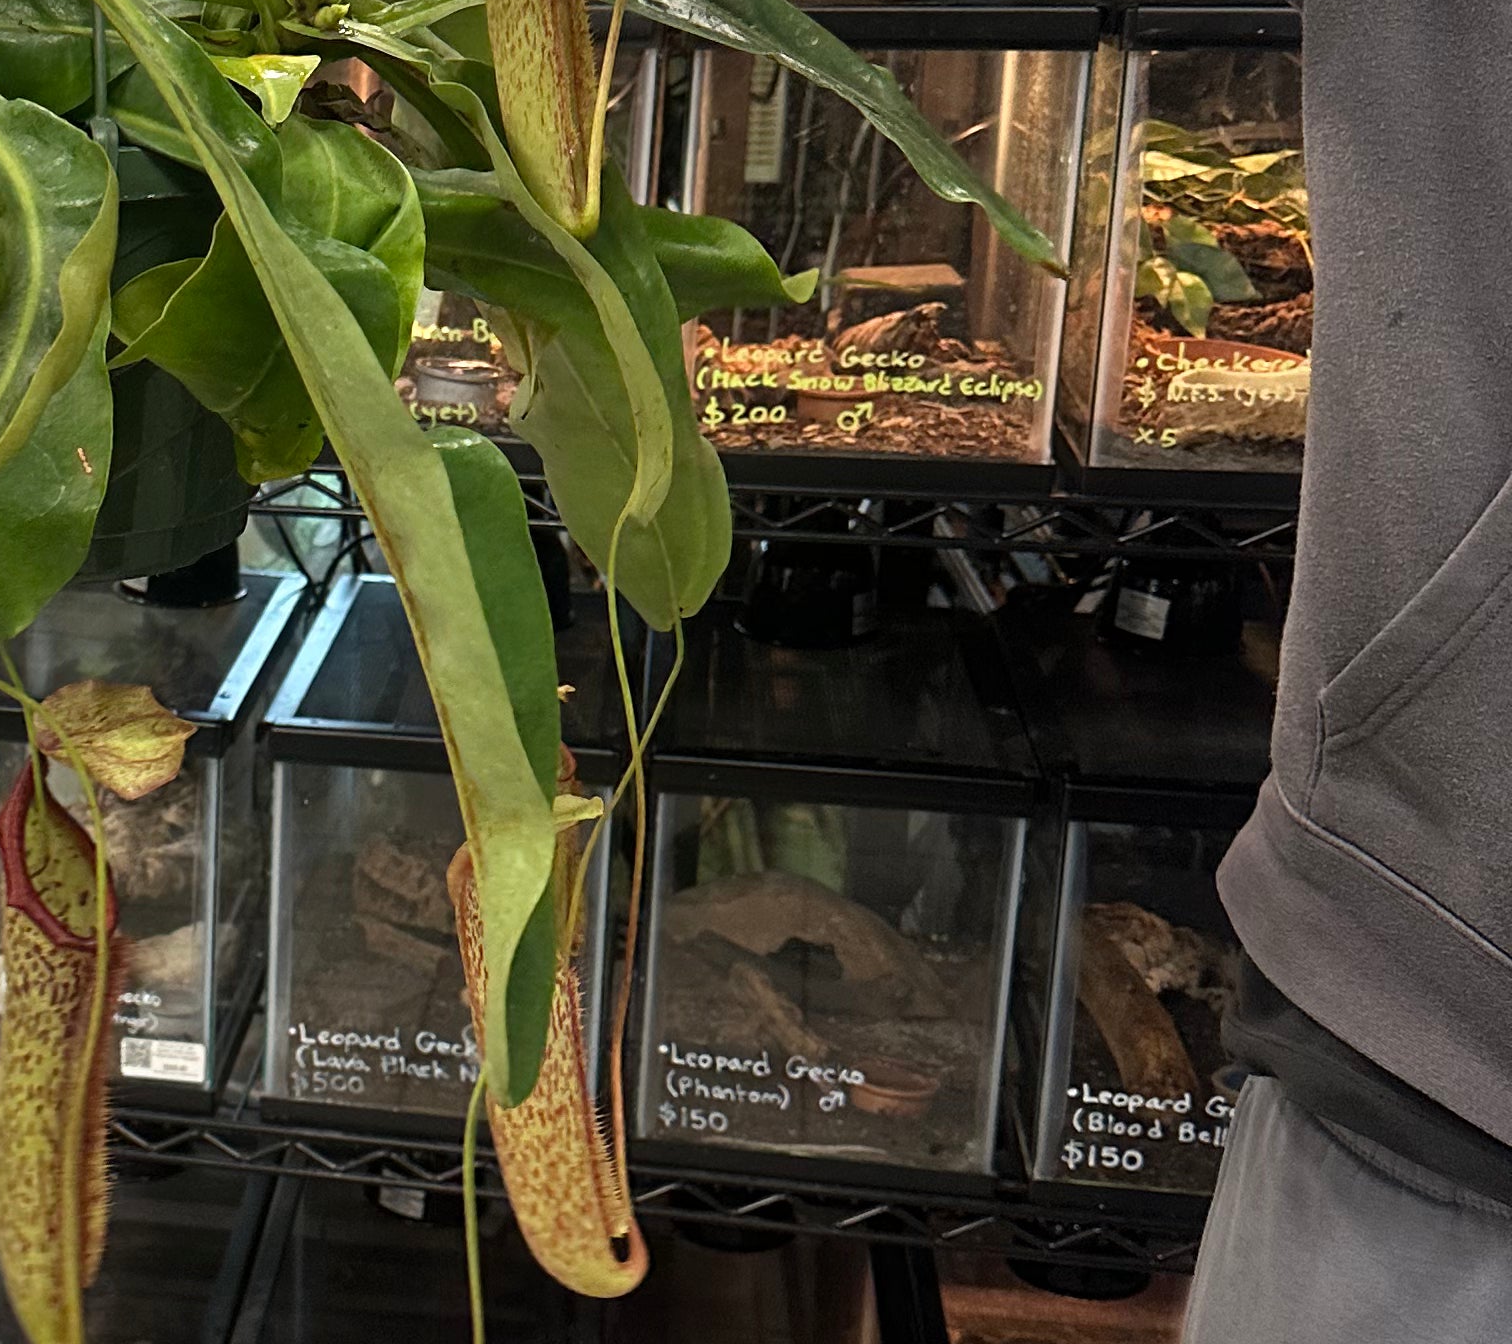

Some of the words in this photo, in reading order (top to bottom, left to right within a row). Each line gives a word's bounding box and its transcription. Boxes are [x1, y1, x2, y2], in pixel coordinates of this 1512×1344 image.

[722, 337, 826, 365] Leopard
[840, 345, 926, 370] Gecko
[696, 366, 778, 391] (Mack
[787, 371, 857, 392] Snow
[862, 371, 952, 397] Blizzard
[959, 374, 1043, 403] Eclipse)
[298, 1022, 402, 1053] Leopard
[294, 1044, 372, 1073] (Lava
[381, 1055, 450, 1081] Black
[670, 1042, 772, 1077] Leopard
[785, 1055, 866, 1086] Gecko
[291, 1070, 366, 1098] $500
[665, 1069, 791, 1111] (Phantom)
[1082, 1083, 1192, 1115] Leopard
[658, 1100, 729, 1133] $150
[1072, 1107, 1164, 1140] (Blood
[1061, 1138, 1145, 1172] $150
